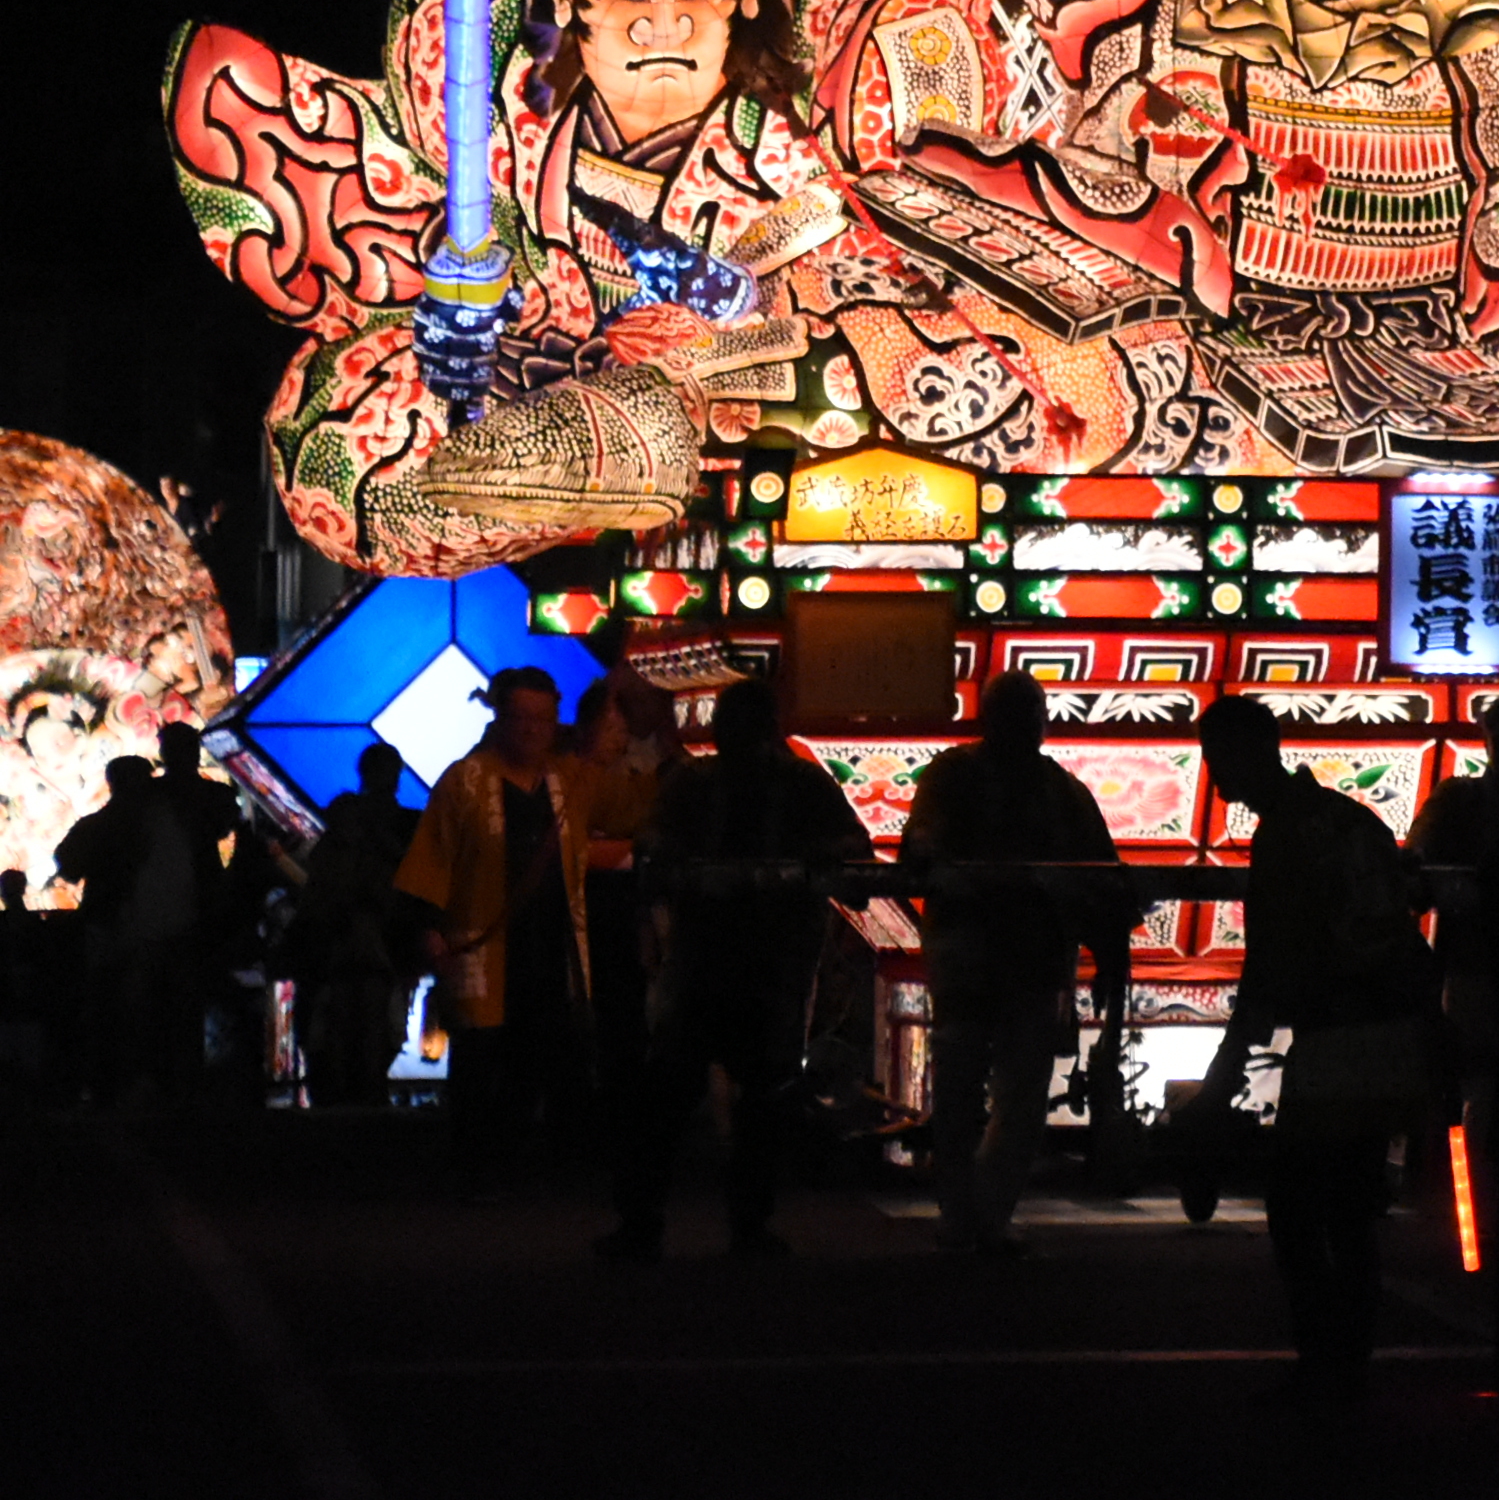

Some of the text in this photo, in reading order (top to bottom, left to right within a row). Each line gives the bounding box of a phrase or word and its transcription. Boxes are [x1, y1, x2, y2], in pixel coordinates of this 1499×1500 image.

[796, 473, 926, 509] 武蔵坊弁慶
[1410, 499, 1476, 656] 議長賞
